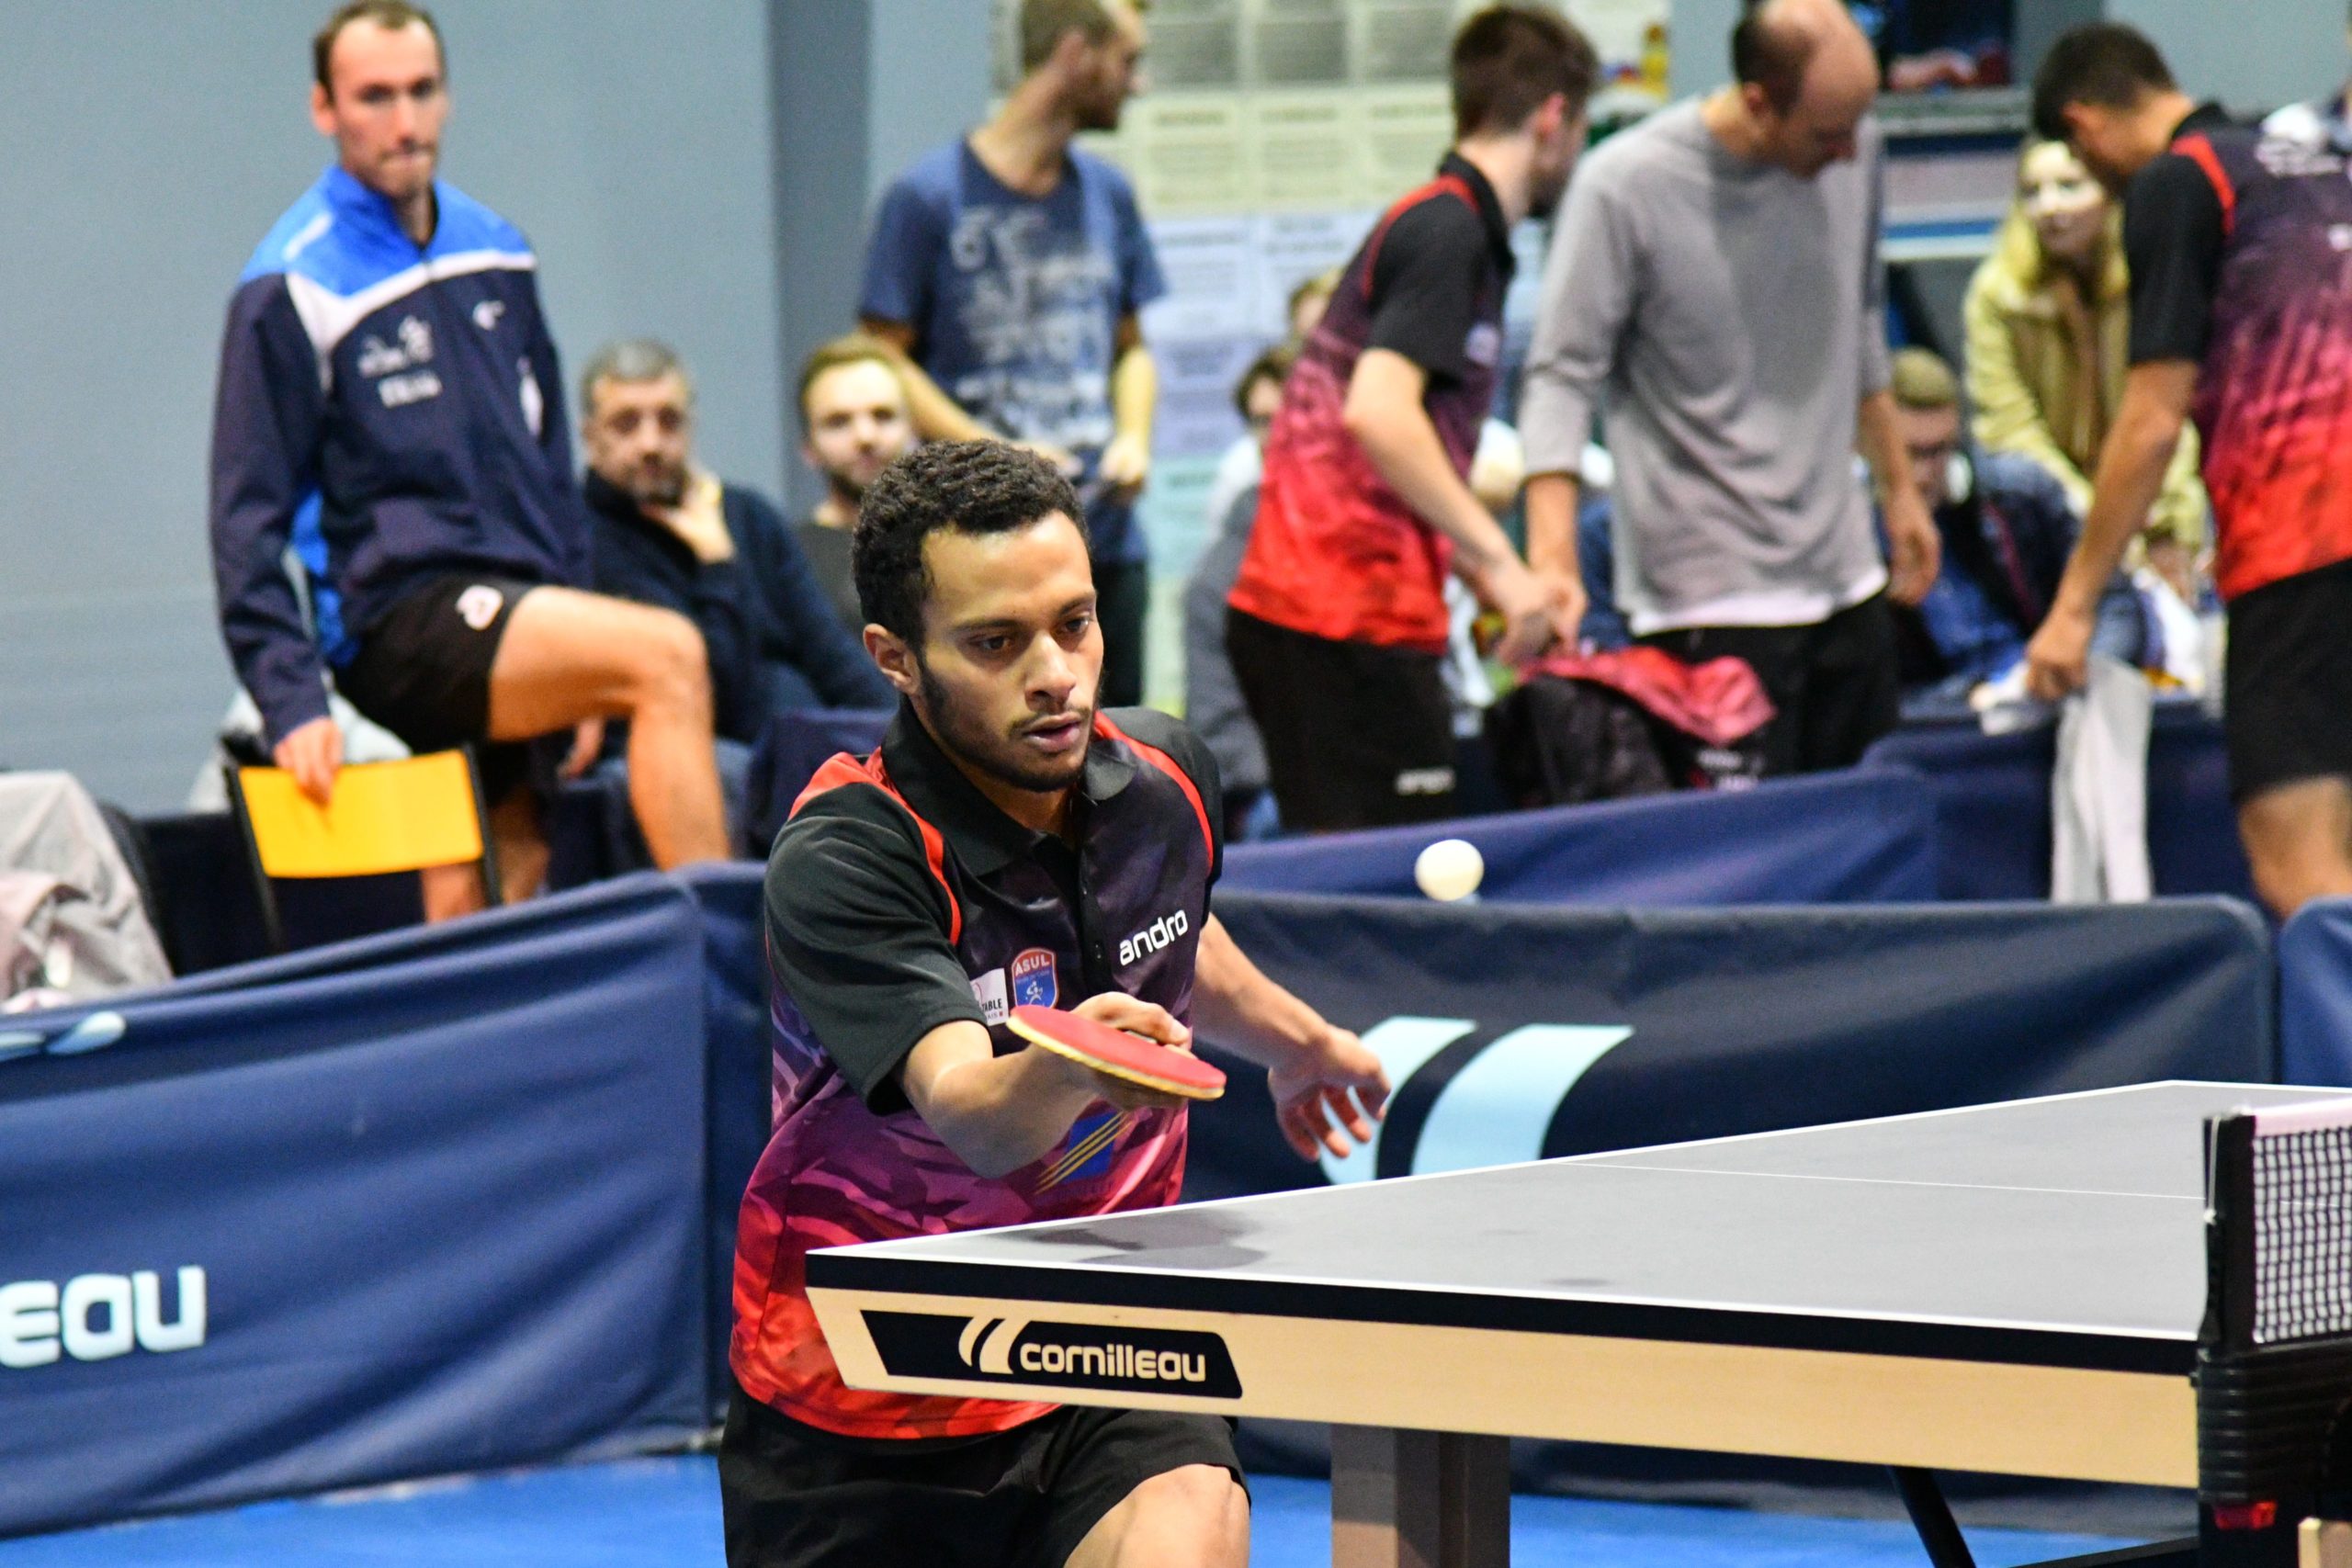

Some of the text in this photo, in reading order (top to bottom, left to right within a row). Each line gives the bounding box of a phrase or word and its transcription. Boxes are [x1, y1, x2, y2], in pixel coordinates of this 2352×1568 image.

[1119, 909, 1188, 966] andro
[1015, 954, 1050, 976] ASUL
[1020, 1342, 1206, 1382] cornilleau
